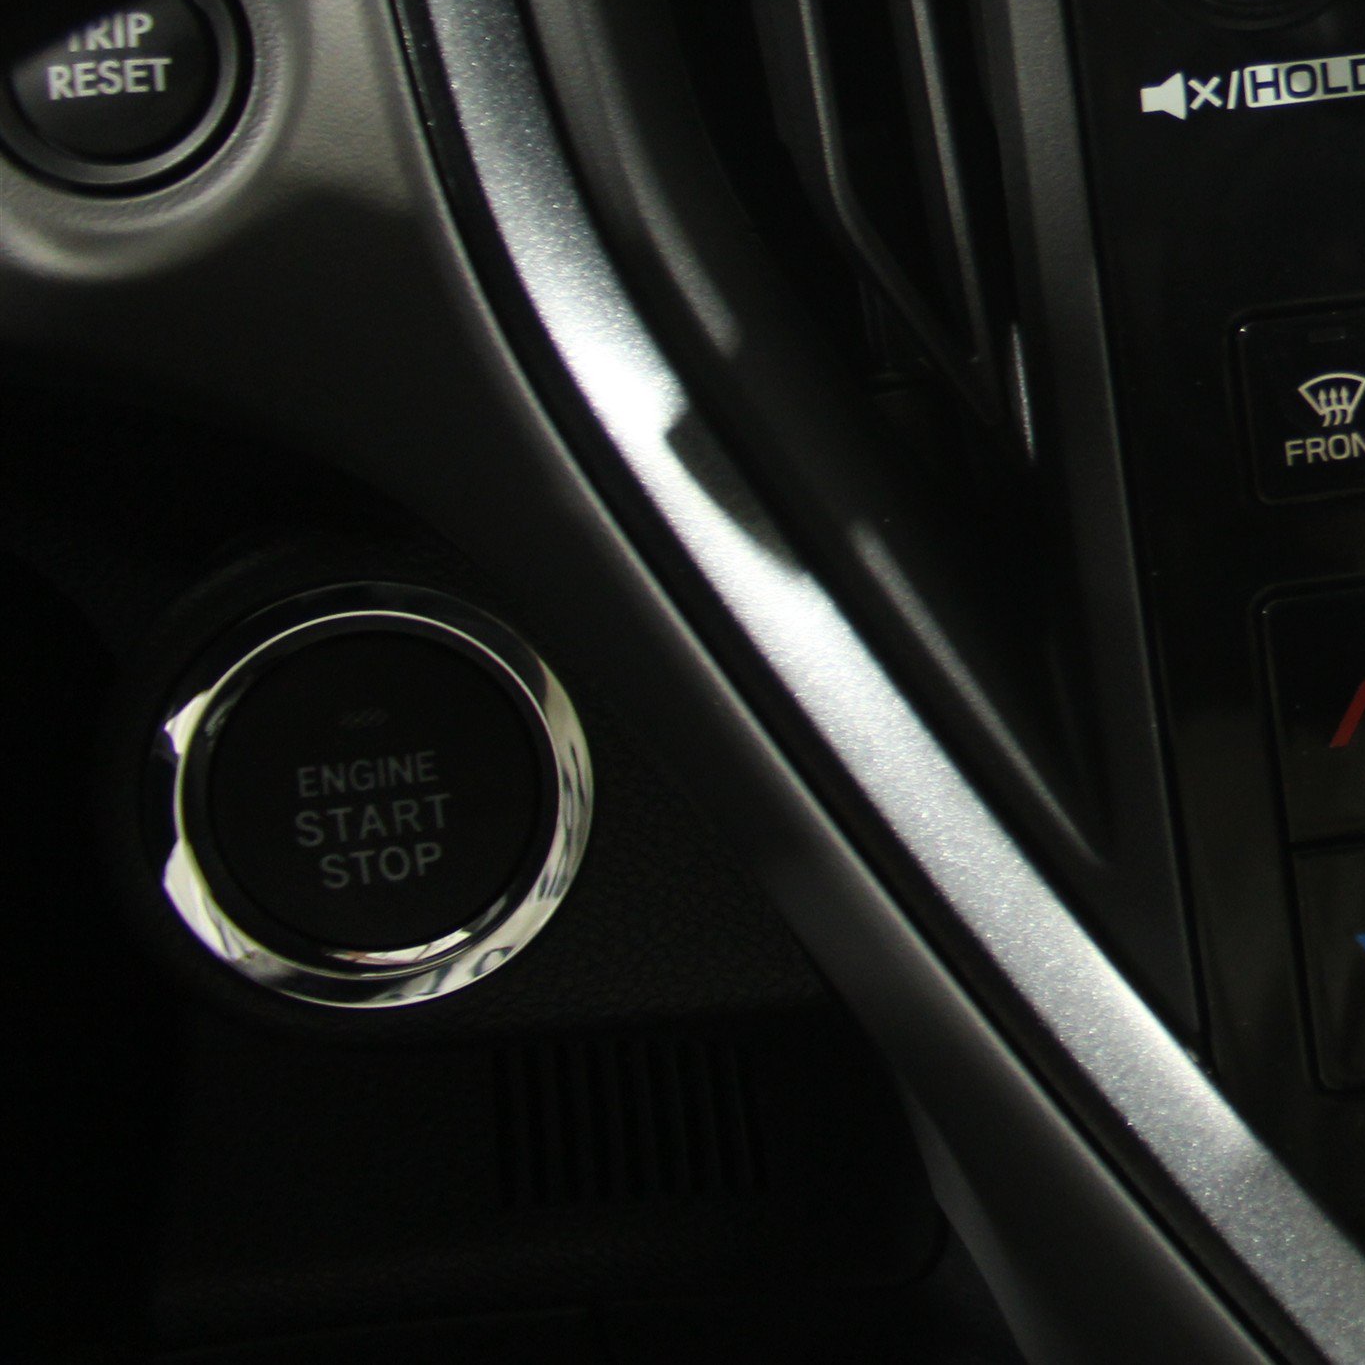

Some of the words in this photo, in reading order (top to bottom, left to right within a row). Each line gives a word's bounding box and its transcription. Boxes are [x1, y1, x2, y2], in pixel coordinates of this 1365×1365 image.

[47, 57, 173, 101] RESET
[297, 750, 439, 798] ENGINE
[295, 793, 452, 848] START
[319, 841, 443, 890] STOP
